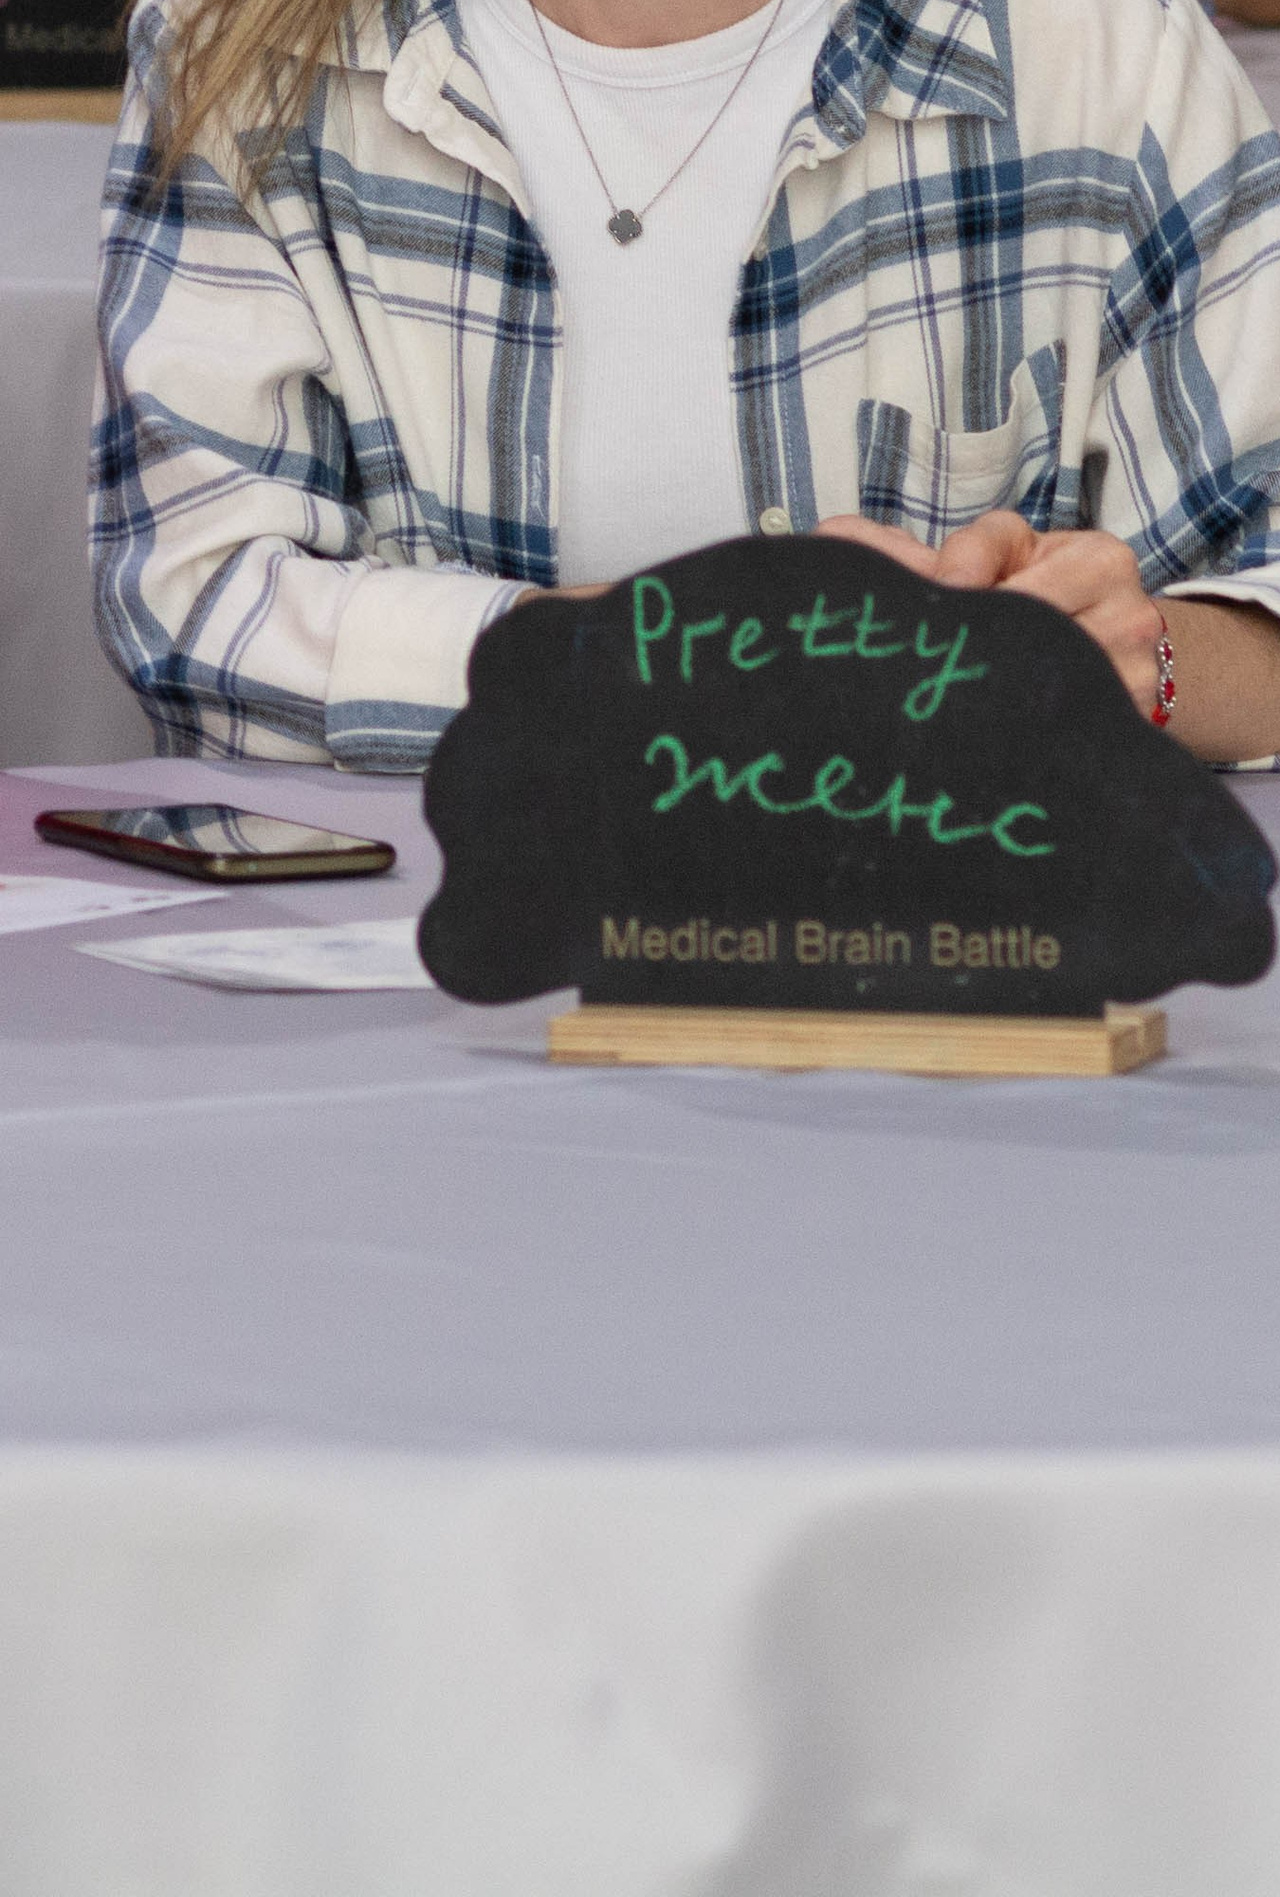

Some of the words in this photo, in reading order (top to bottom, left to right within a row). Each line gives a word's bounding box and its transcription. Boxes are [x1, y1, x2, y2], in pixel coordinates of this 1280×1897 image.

[633, 577, 988, 720] Pretty
[602, 917, 778, 962] Medical
[795, 919, 912, 965] Brain
[929, 922, 1062, 970] Battle
